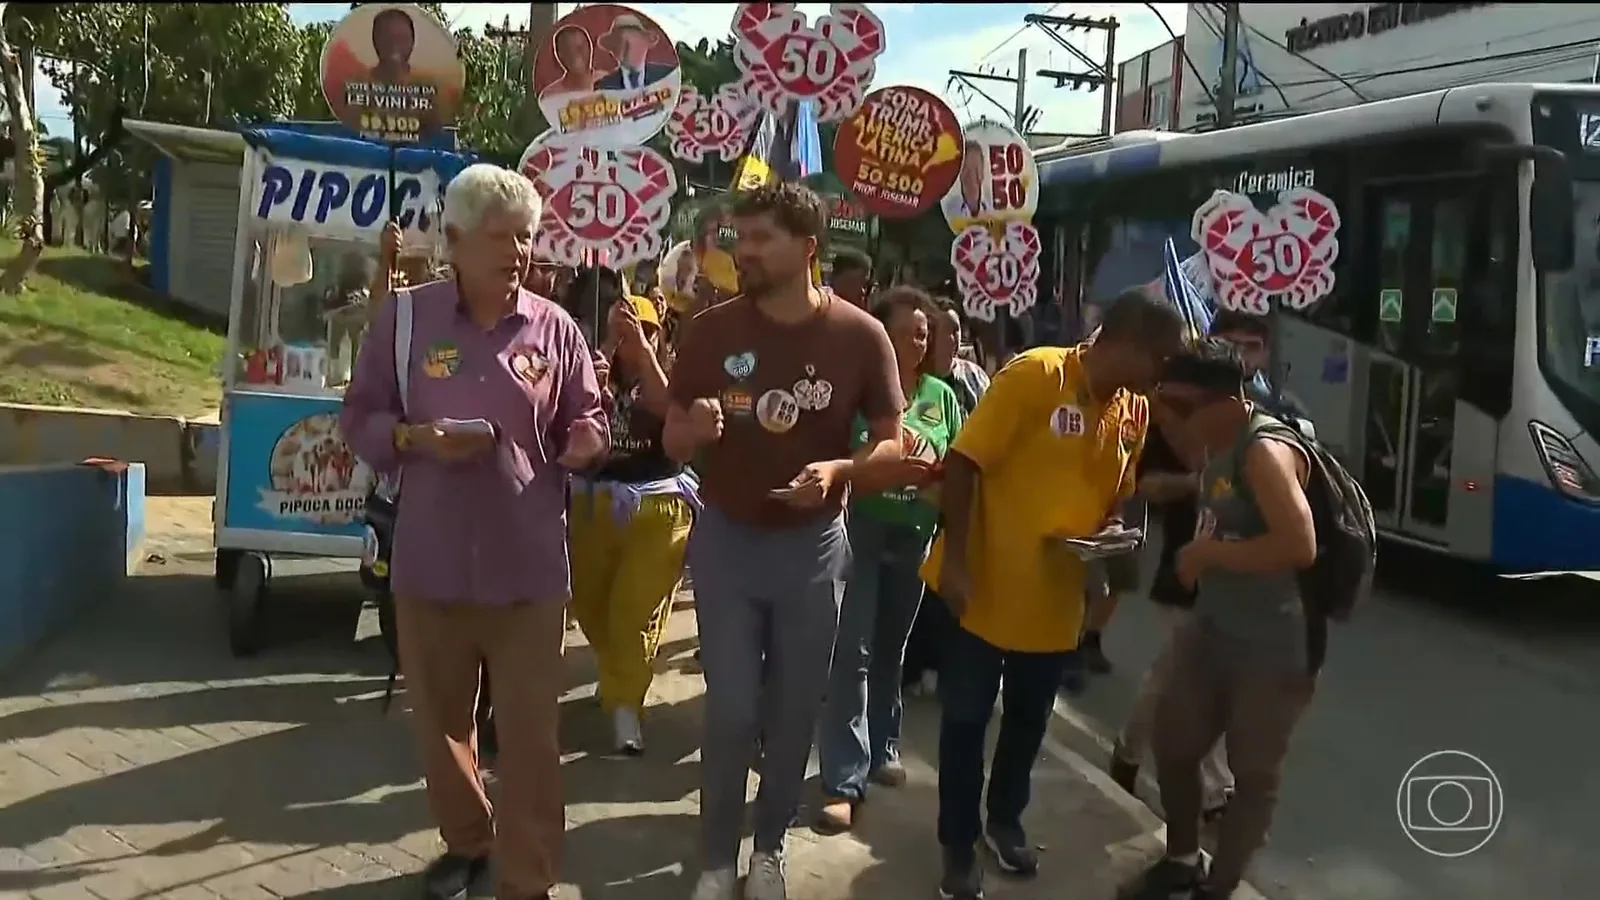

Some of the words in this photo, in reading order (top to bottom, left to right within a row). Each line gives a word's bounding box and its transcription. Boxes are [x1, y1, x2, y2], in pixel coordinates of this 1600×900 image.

[777, 38, 836, 85] 50
[347, 93, 370, 106] LEI
[375, 95, 406, 108] VINI
[411, 98, 433, 110] JR.
[422, 85, 436, 95] DA
[881, 88, 930, 119] FORA
[693, 107, 731, 138] 50
[870, 102, 932, 140] TRUMP
[856, 137, 920, 168] LATINA
[989, 142, 1024, 176] 50
[991, 177, 1026, 210] 50
[1238, 166, 1315, 194] Ceramica
[567, 183, 627, 228] 50
[880, 190, 920, 208] JOSEMAR
[829, 216, 867, 233] JOSEMAR
[985, 253, 1018, 292] 50
[1252, 235, 1302, 282] 50
[280, 498, 331, 514] PIPOCA
